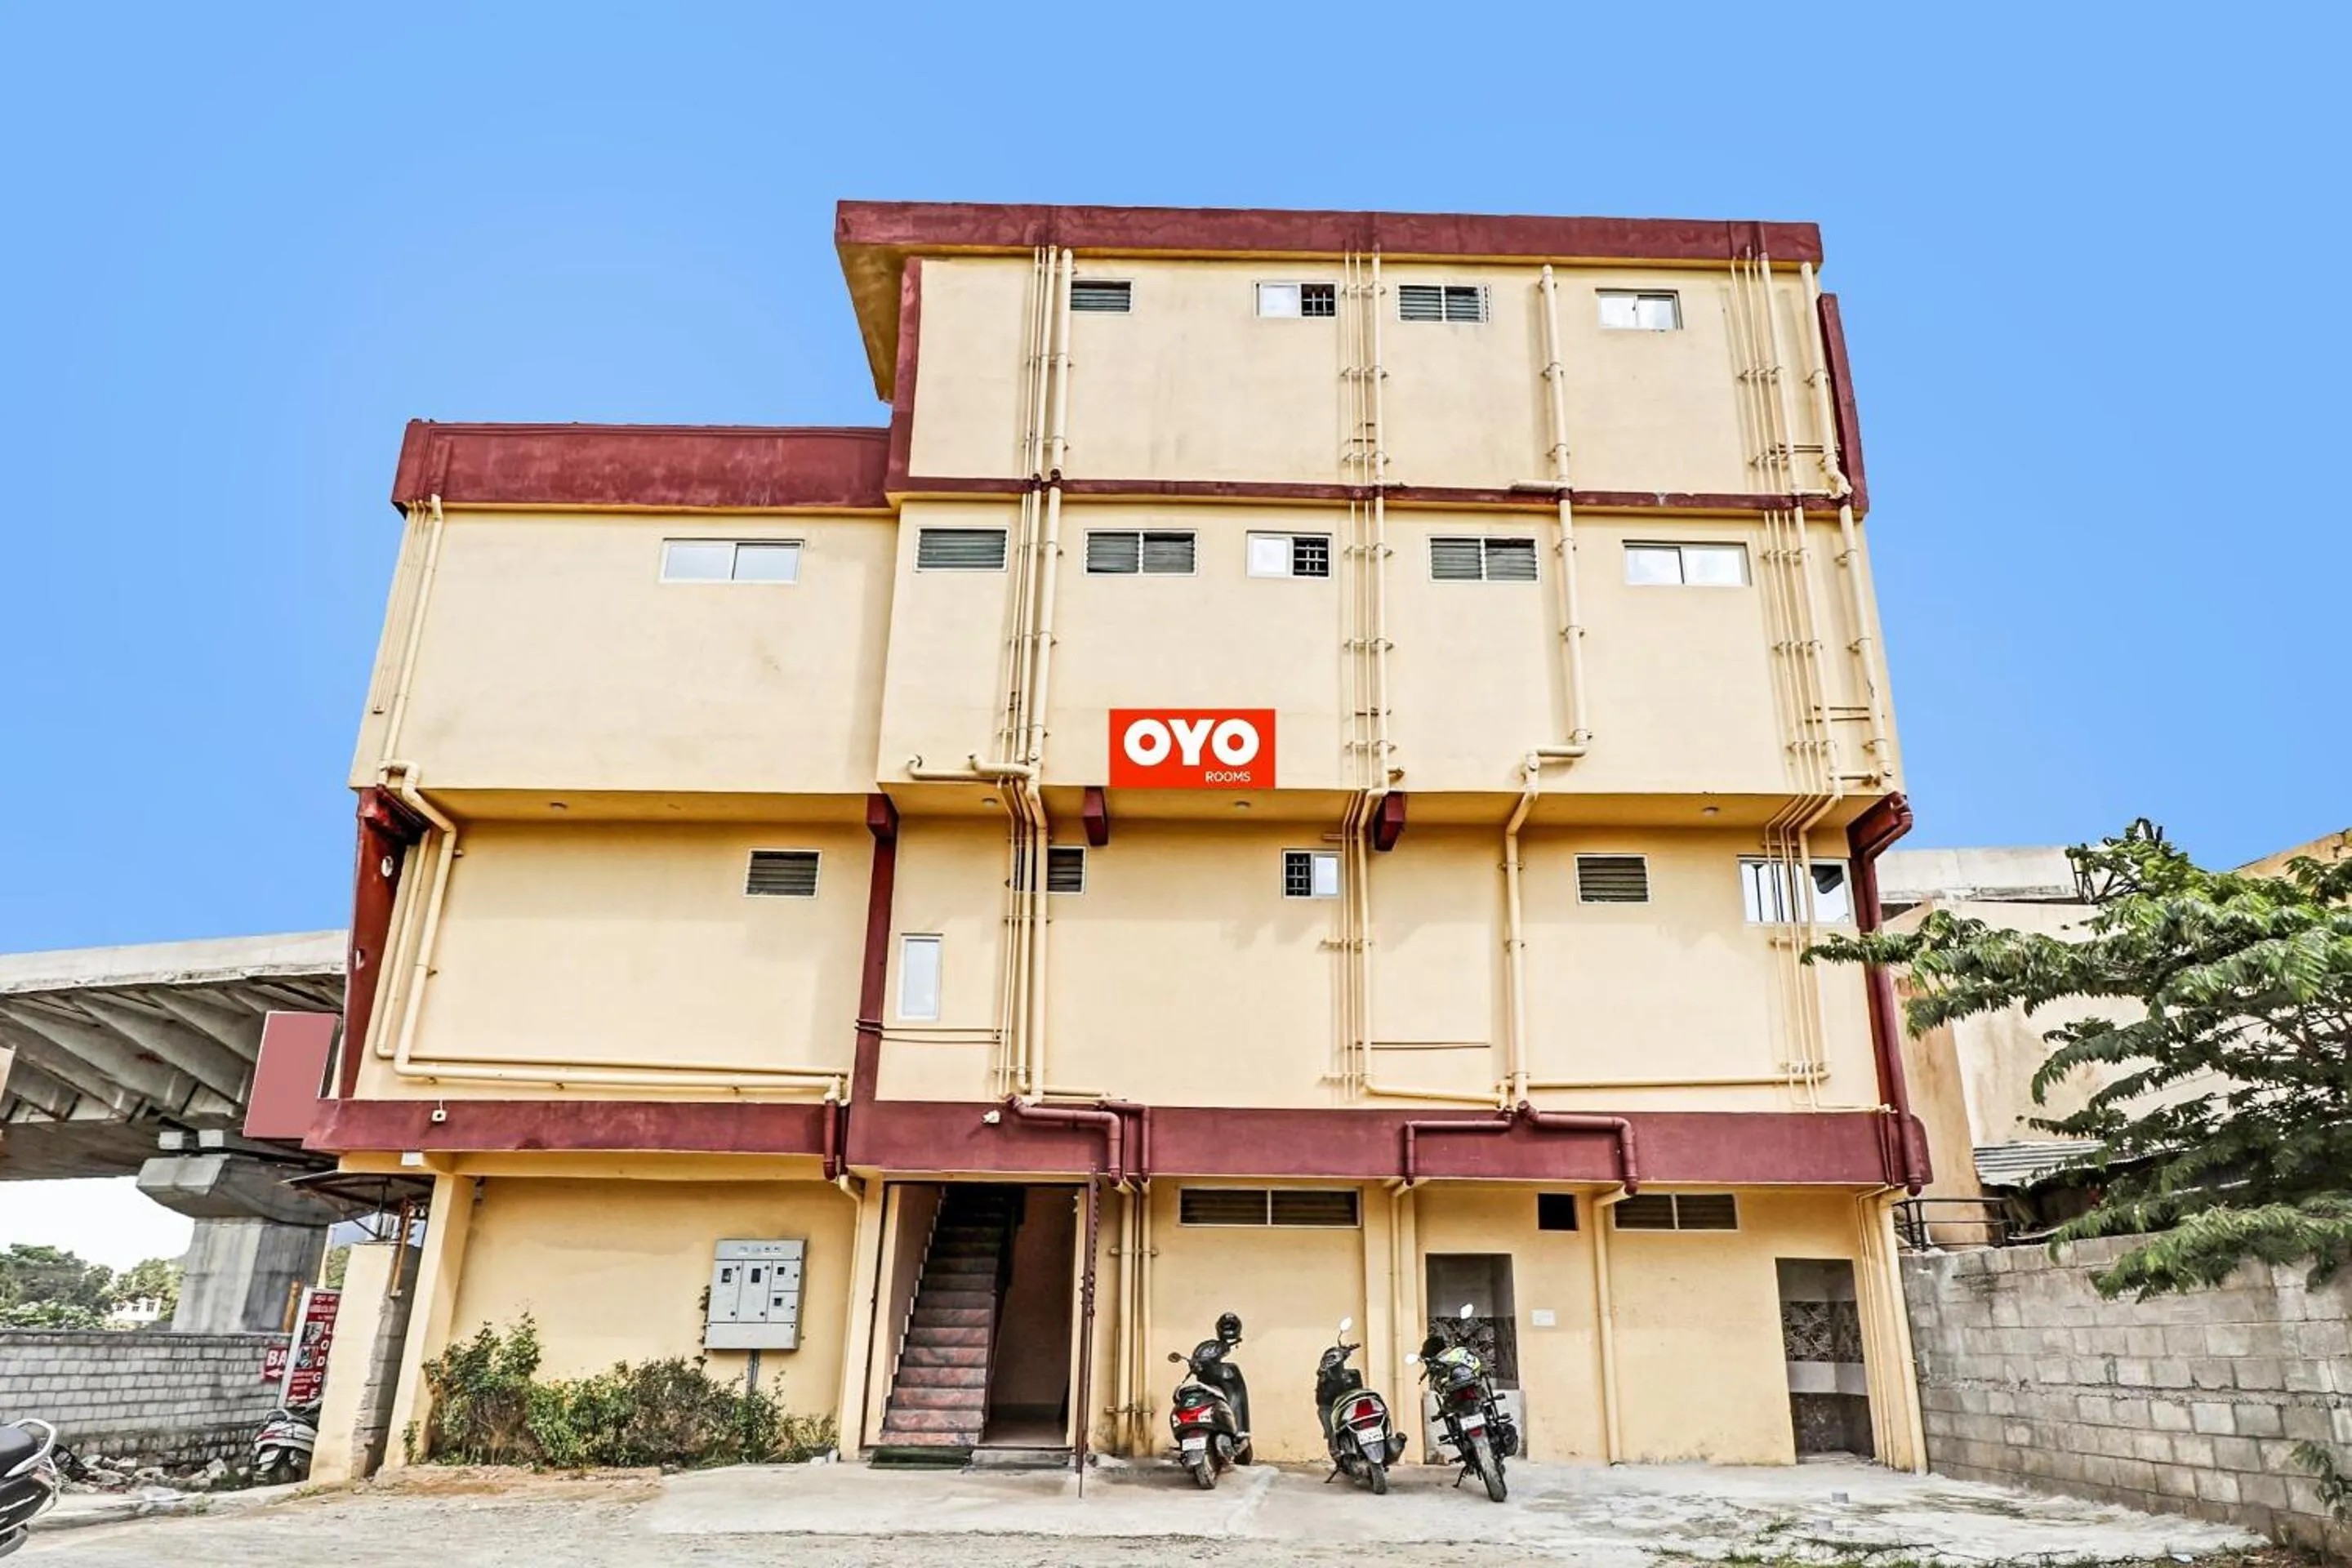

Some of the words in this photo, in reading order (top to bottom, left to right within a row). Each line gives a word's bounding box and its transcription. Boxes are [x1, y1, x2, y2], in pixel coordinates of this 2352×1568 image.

[1124, 718, 1259, 766] OYO
[1205, 771, 1251, 782] ROOMS
[309, 1323, 332, 1399] LODGE
